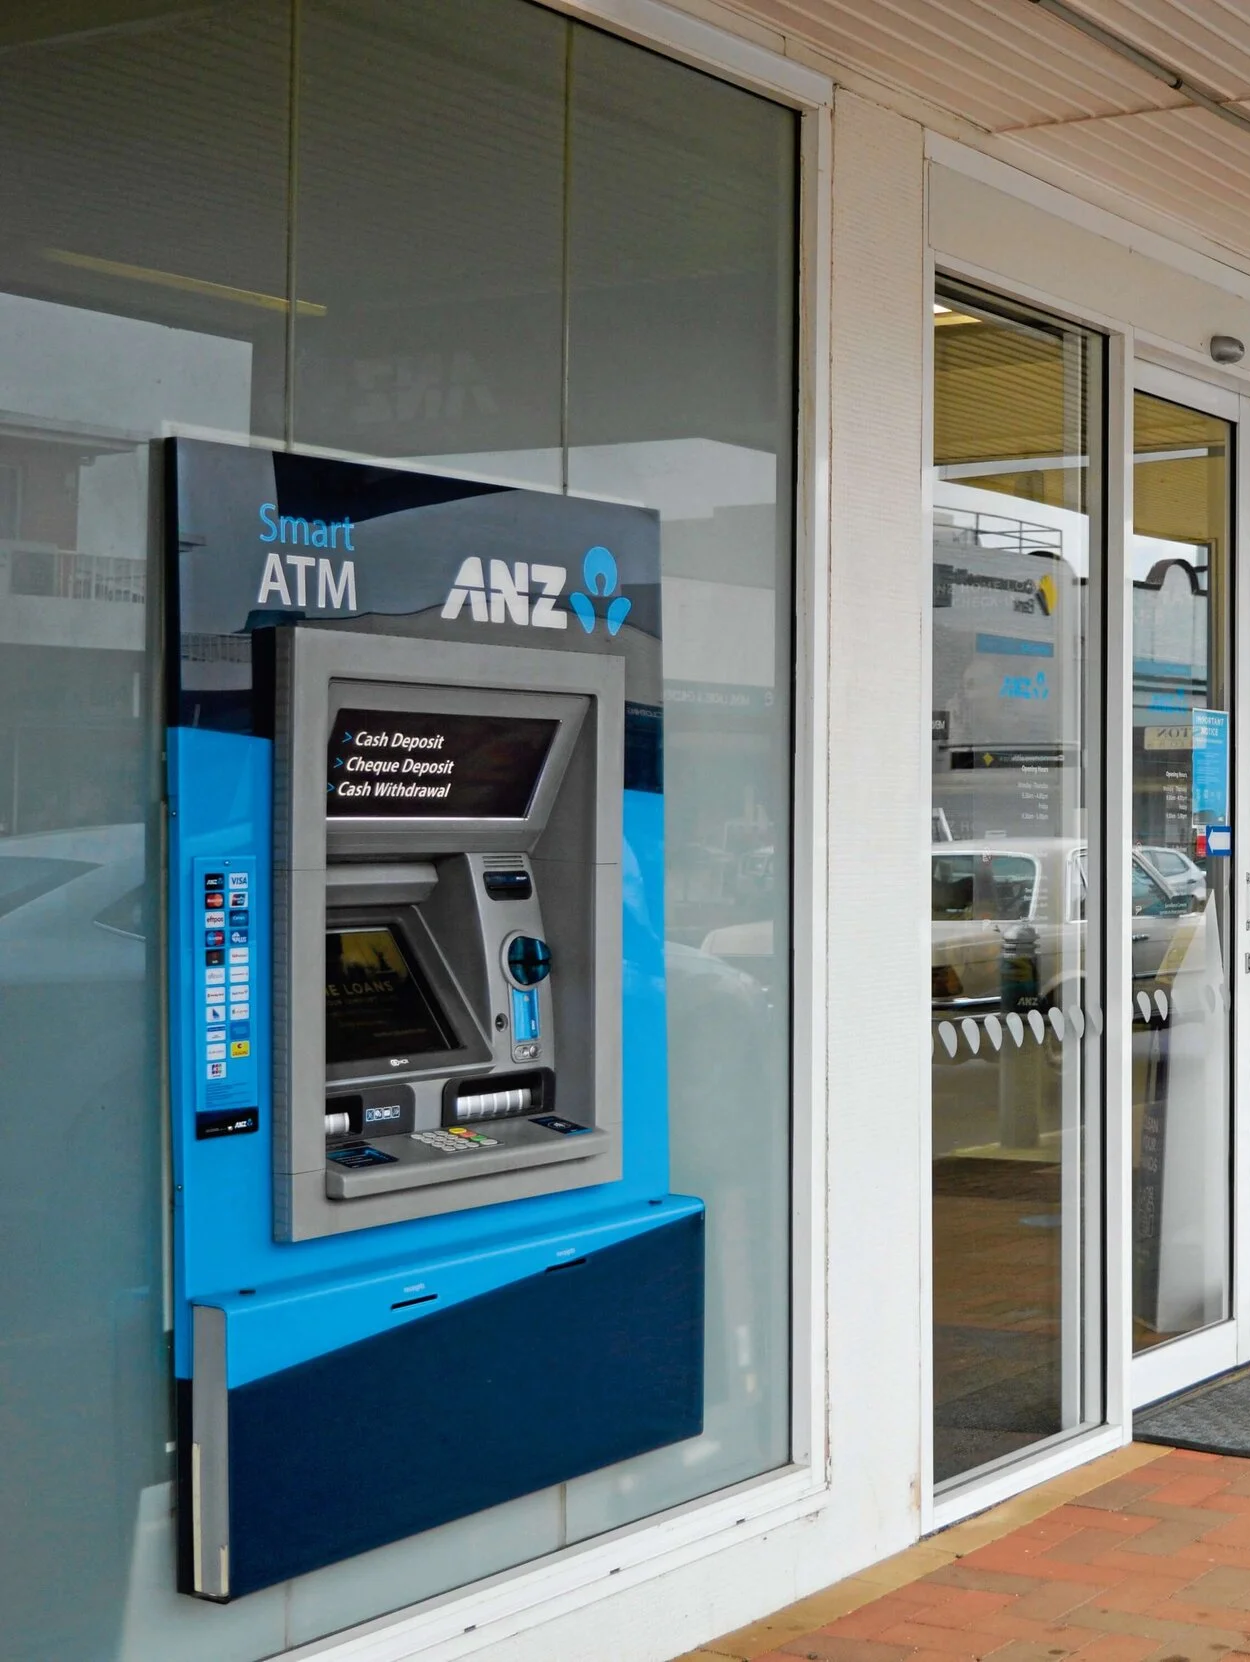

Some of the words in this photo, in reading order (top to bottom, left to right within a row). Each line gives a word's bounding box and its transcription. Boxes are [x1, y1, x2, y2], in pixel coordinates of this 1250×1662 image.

[258, 502, 356, 552] Smart
[256, 552, 358, 612] ATM
[440, 556, 568, 629] ANZ
[355, 731, 389, 747] Cash
[391, 732, 445, 752] Deposit
[346, 756, 400, 776] Cheque
[402, 758, 455, 777] Deposit
[338, 781, 372, 797] Cash
[374, 782, 452, 798] Withdrawal
[231, 876, 247, 885] VISA
[343, 980, 394, 995] LOANS
